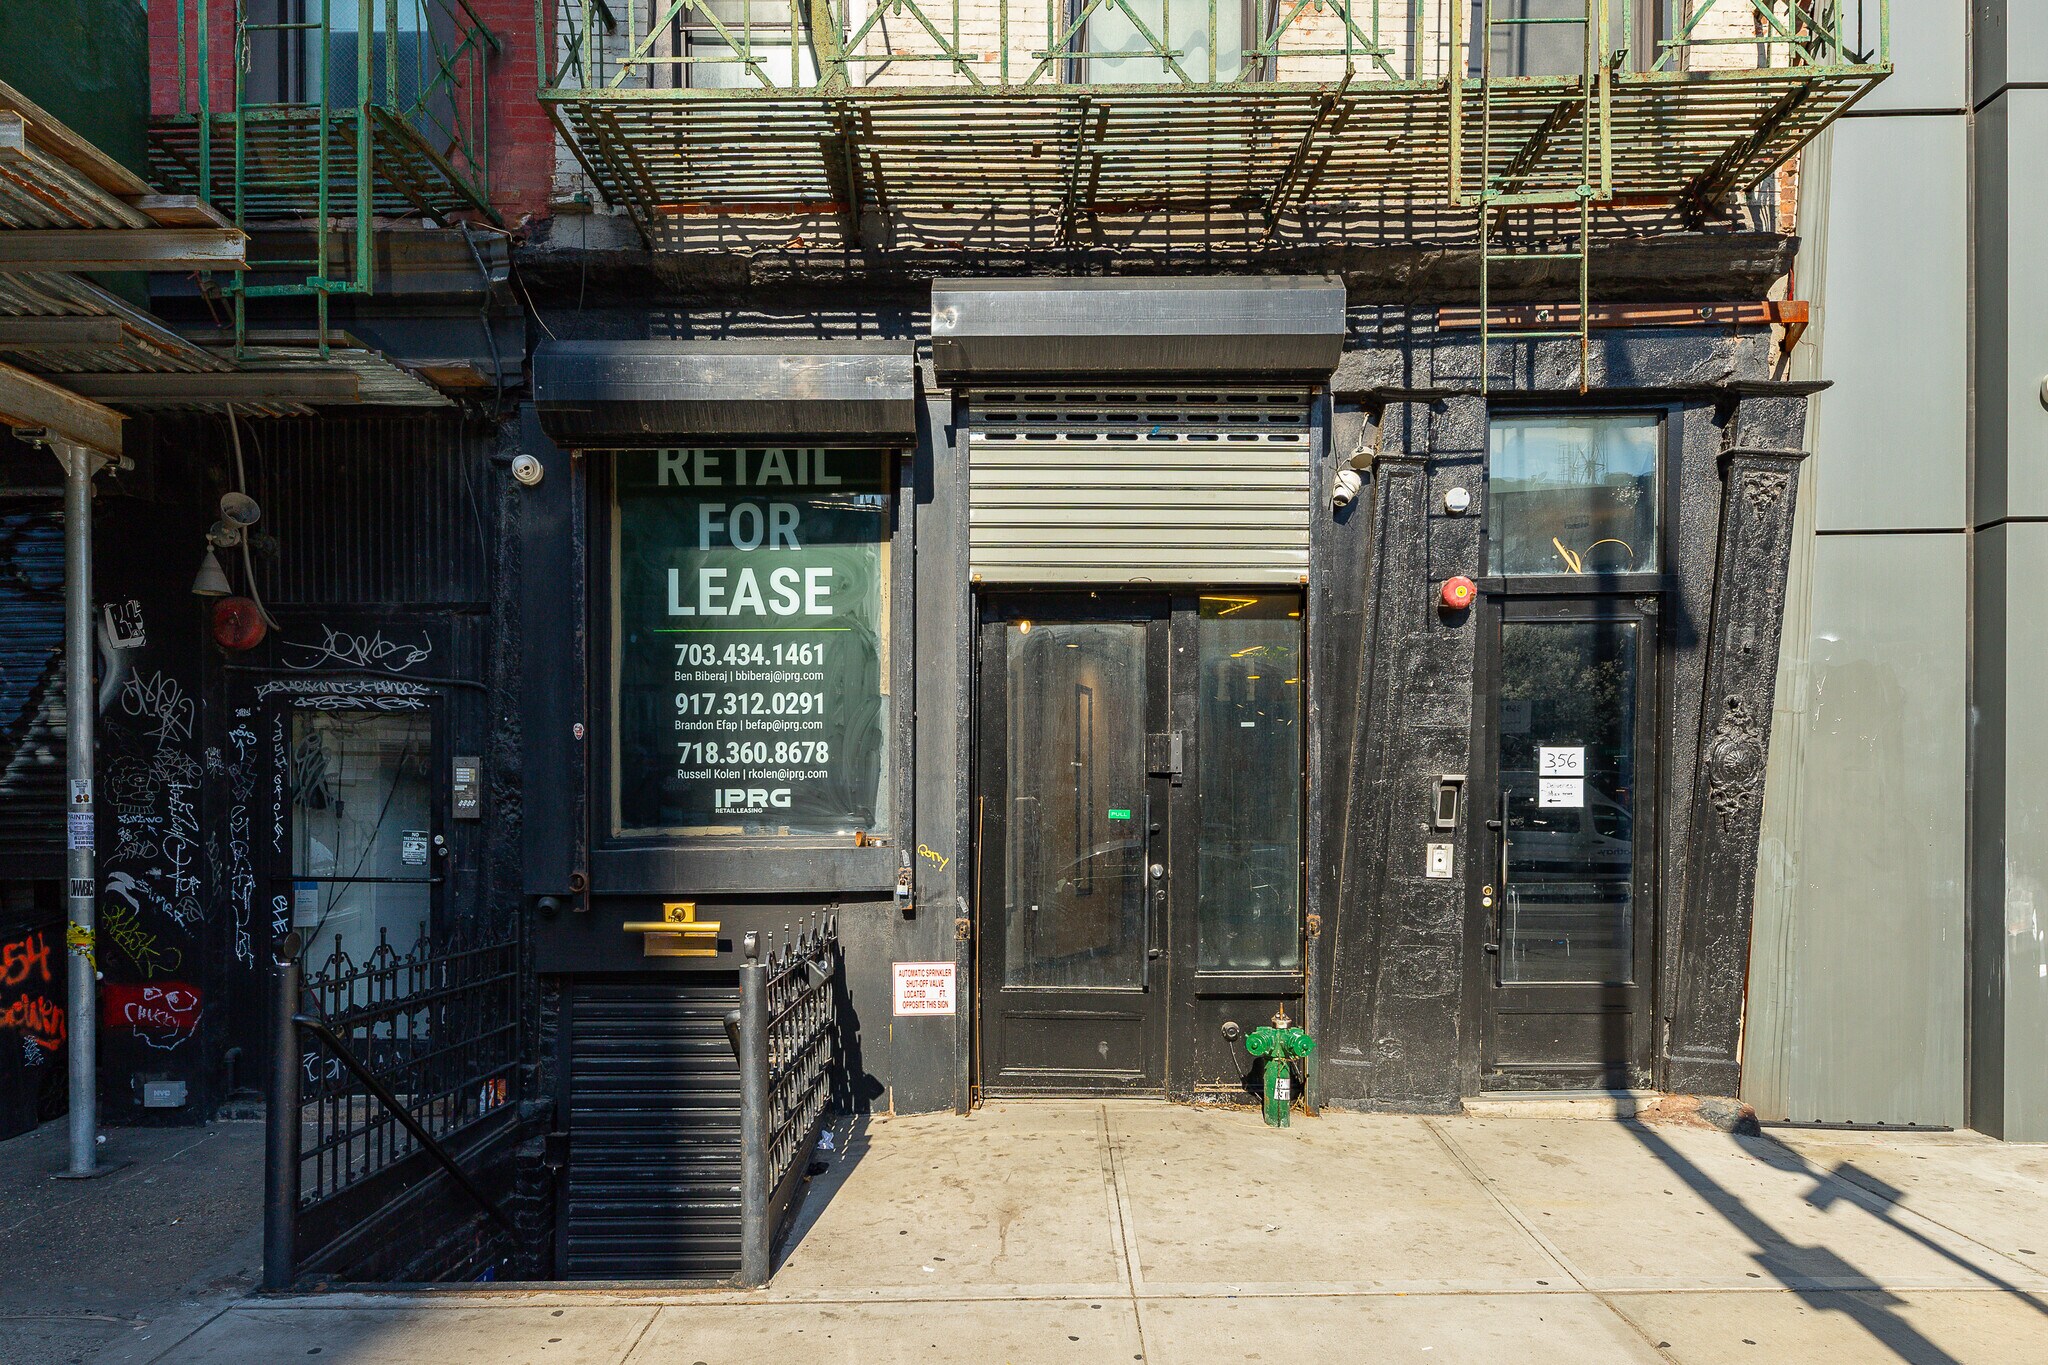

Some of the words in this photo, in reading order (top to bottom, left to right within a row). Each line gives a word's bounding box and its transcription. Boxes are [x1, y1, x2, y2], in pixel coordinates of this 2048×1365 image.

[658, 448, 842, 486] RETAIL
[699, 502, 802, 551] FOR
[668, 567, 833, 616] LEASE
[674, 643, 824, 666] 703.434.1461
[674, 671, 693, 681] Ben
[695, 671, 728, 683] Biberaj
[735, 671, 824, 683] bbiberaj@iprg.com
[675, 692, 824, 715] 917.312.0291
[674, 720, 714, 730] Brandon
[716, 720, 738, 732] Efap
[745, 720, 823, 732] befap@iprg.com
[677, 741, 829, 764] 718.360.8678
[1545, 752, 1577, 769] 356
[677, 768, 712, 779] Russell
[714, 768, 741, 779] Kolen
[748, 768, 828, 781] rkolen@iprg.com
[715, 788, 791, 808] IPRG
[898, 969, 925, 977] AUTOMATIC
[926, 968, 952, 977] SPRINKLER
[906, 979, 928, 988] SHUT-OFF
[929, 979, 945, 988] VALVE
[903, 990, 926, 998] LOCATED
[902, 1001, 925, 1009] OPPOSITE
[926, 1000, 937, 1009] THIS
[937, 1000, 949, 1009] SIGN
